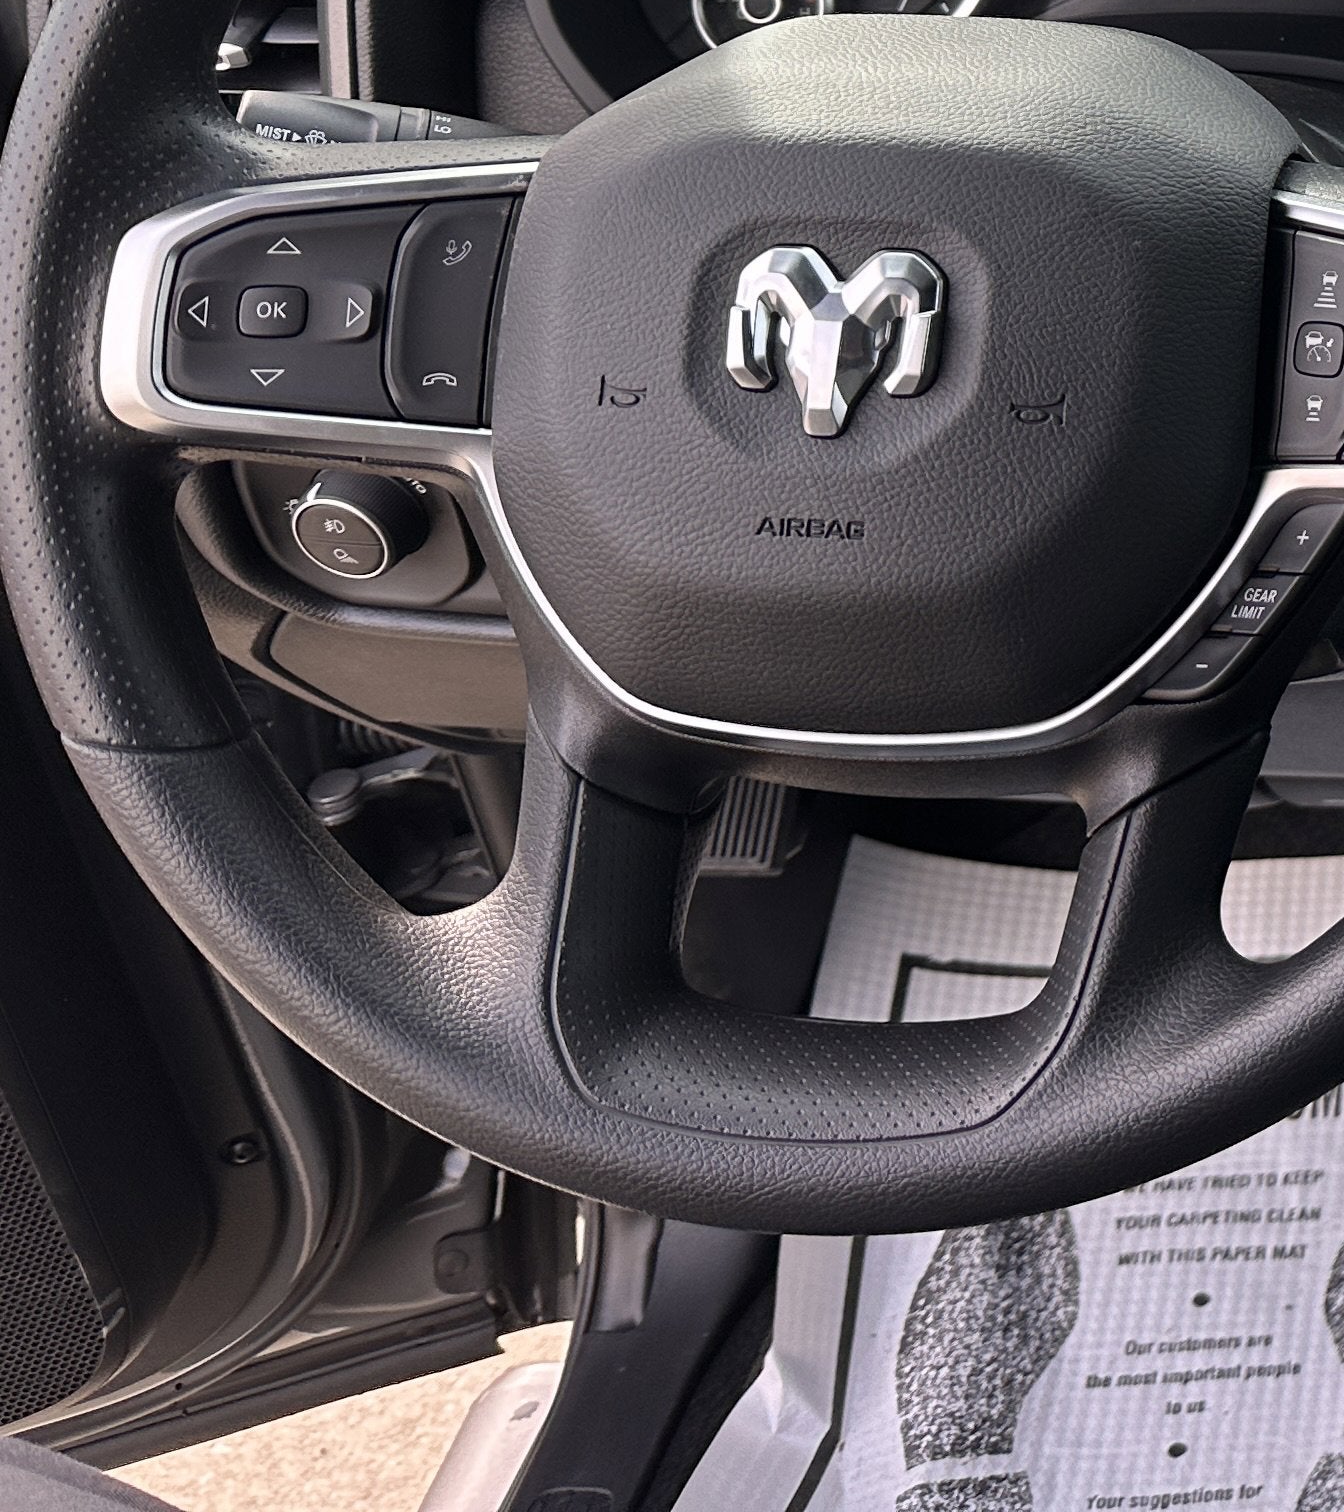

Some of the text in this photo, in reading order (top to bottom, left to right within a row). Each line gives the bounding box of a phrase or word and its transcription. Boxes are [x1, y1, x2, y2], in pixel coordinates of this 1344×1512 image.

[255, 123, 292, 141] MIST
[256, 302, 286, 319] OK
[756, 517, 865, 541] AIRBAG
[1244, 588, 1277, 603] GEAR
[1231, 605, 1265, 619] LIMIT
[1153, 1176, 1198, 1193] HAVE
[1202, 1174, 1251, 1189] TRIED
[1256, 1171, 1278, 1187] TO
[1282, 1169, 1325, 1187] KEEP
[1116, 1206, 1322, 1230] YOUR CARPETING CLEAN
[1118, 1244, 1307, 1266] WITH THIS PAPER MAT
[1125, 1334, 1273, 1356] Our customers are
[1085, 1361, 1302, 1389] the most important people
[1165, 1400, 1182, 1415] to
[1087, 1484, 1264, 1511] Your suggestions for
